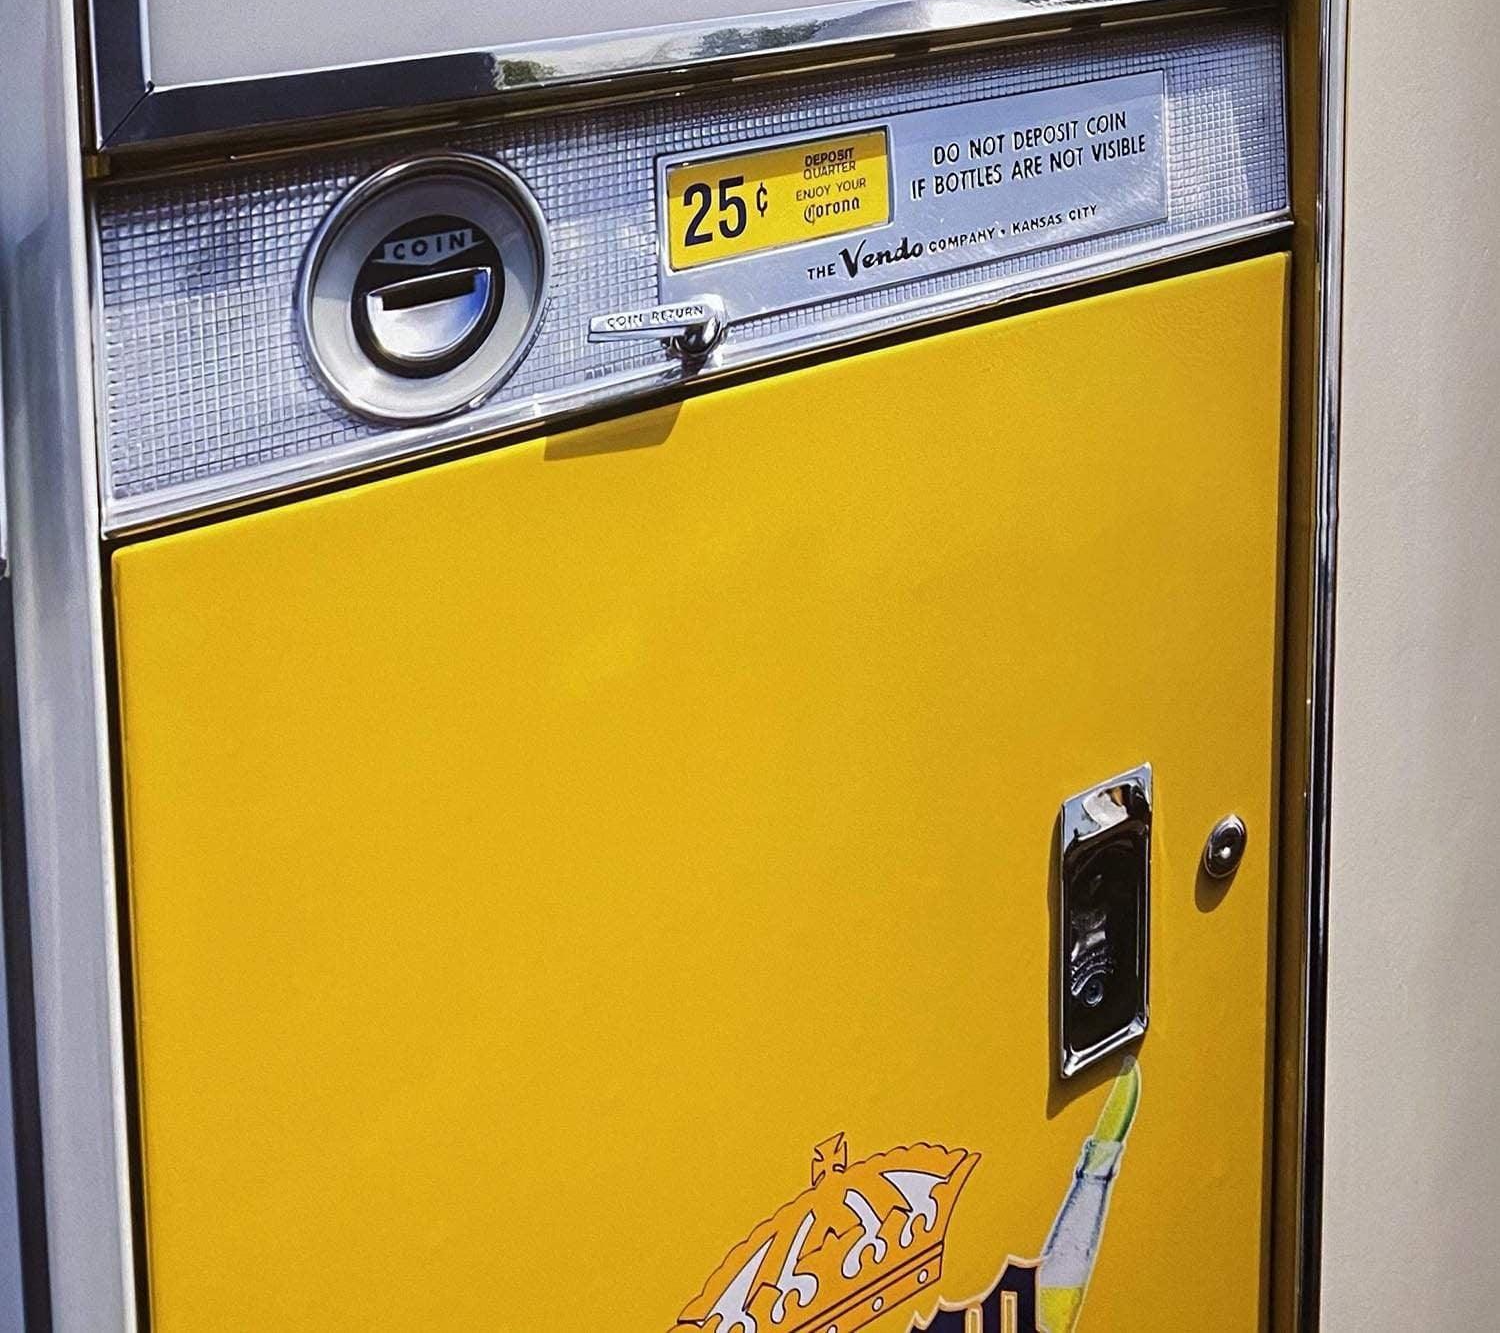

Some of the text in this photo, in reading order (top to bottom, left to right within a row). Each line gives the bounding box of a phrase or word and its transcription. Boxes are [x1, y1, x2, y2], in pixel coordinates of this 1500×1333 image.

[934, 111, 1126, 165] DO NOT DEPOSIT COIN
[803, 160, 856, 180] QUARTER
[804, 147, 855, 168] DEPOSIT
[912, 134, 1146, 199] IF BOTTLES ARE NOT VISIBLE
[796, 177, 867, 202] ENJOY YOUR
[803, 196, 860, 226] Corona
[393, 231, 466, 260] COIN
[807, 204, 1098, 281] THE Vendo COMPANY KANSAS CITY
[606, 305, 704, 328] COIN RETURN
